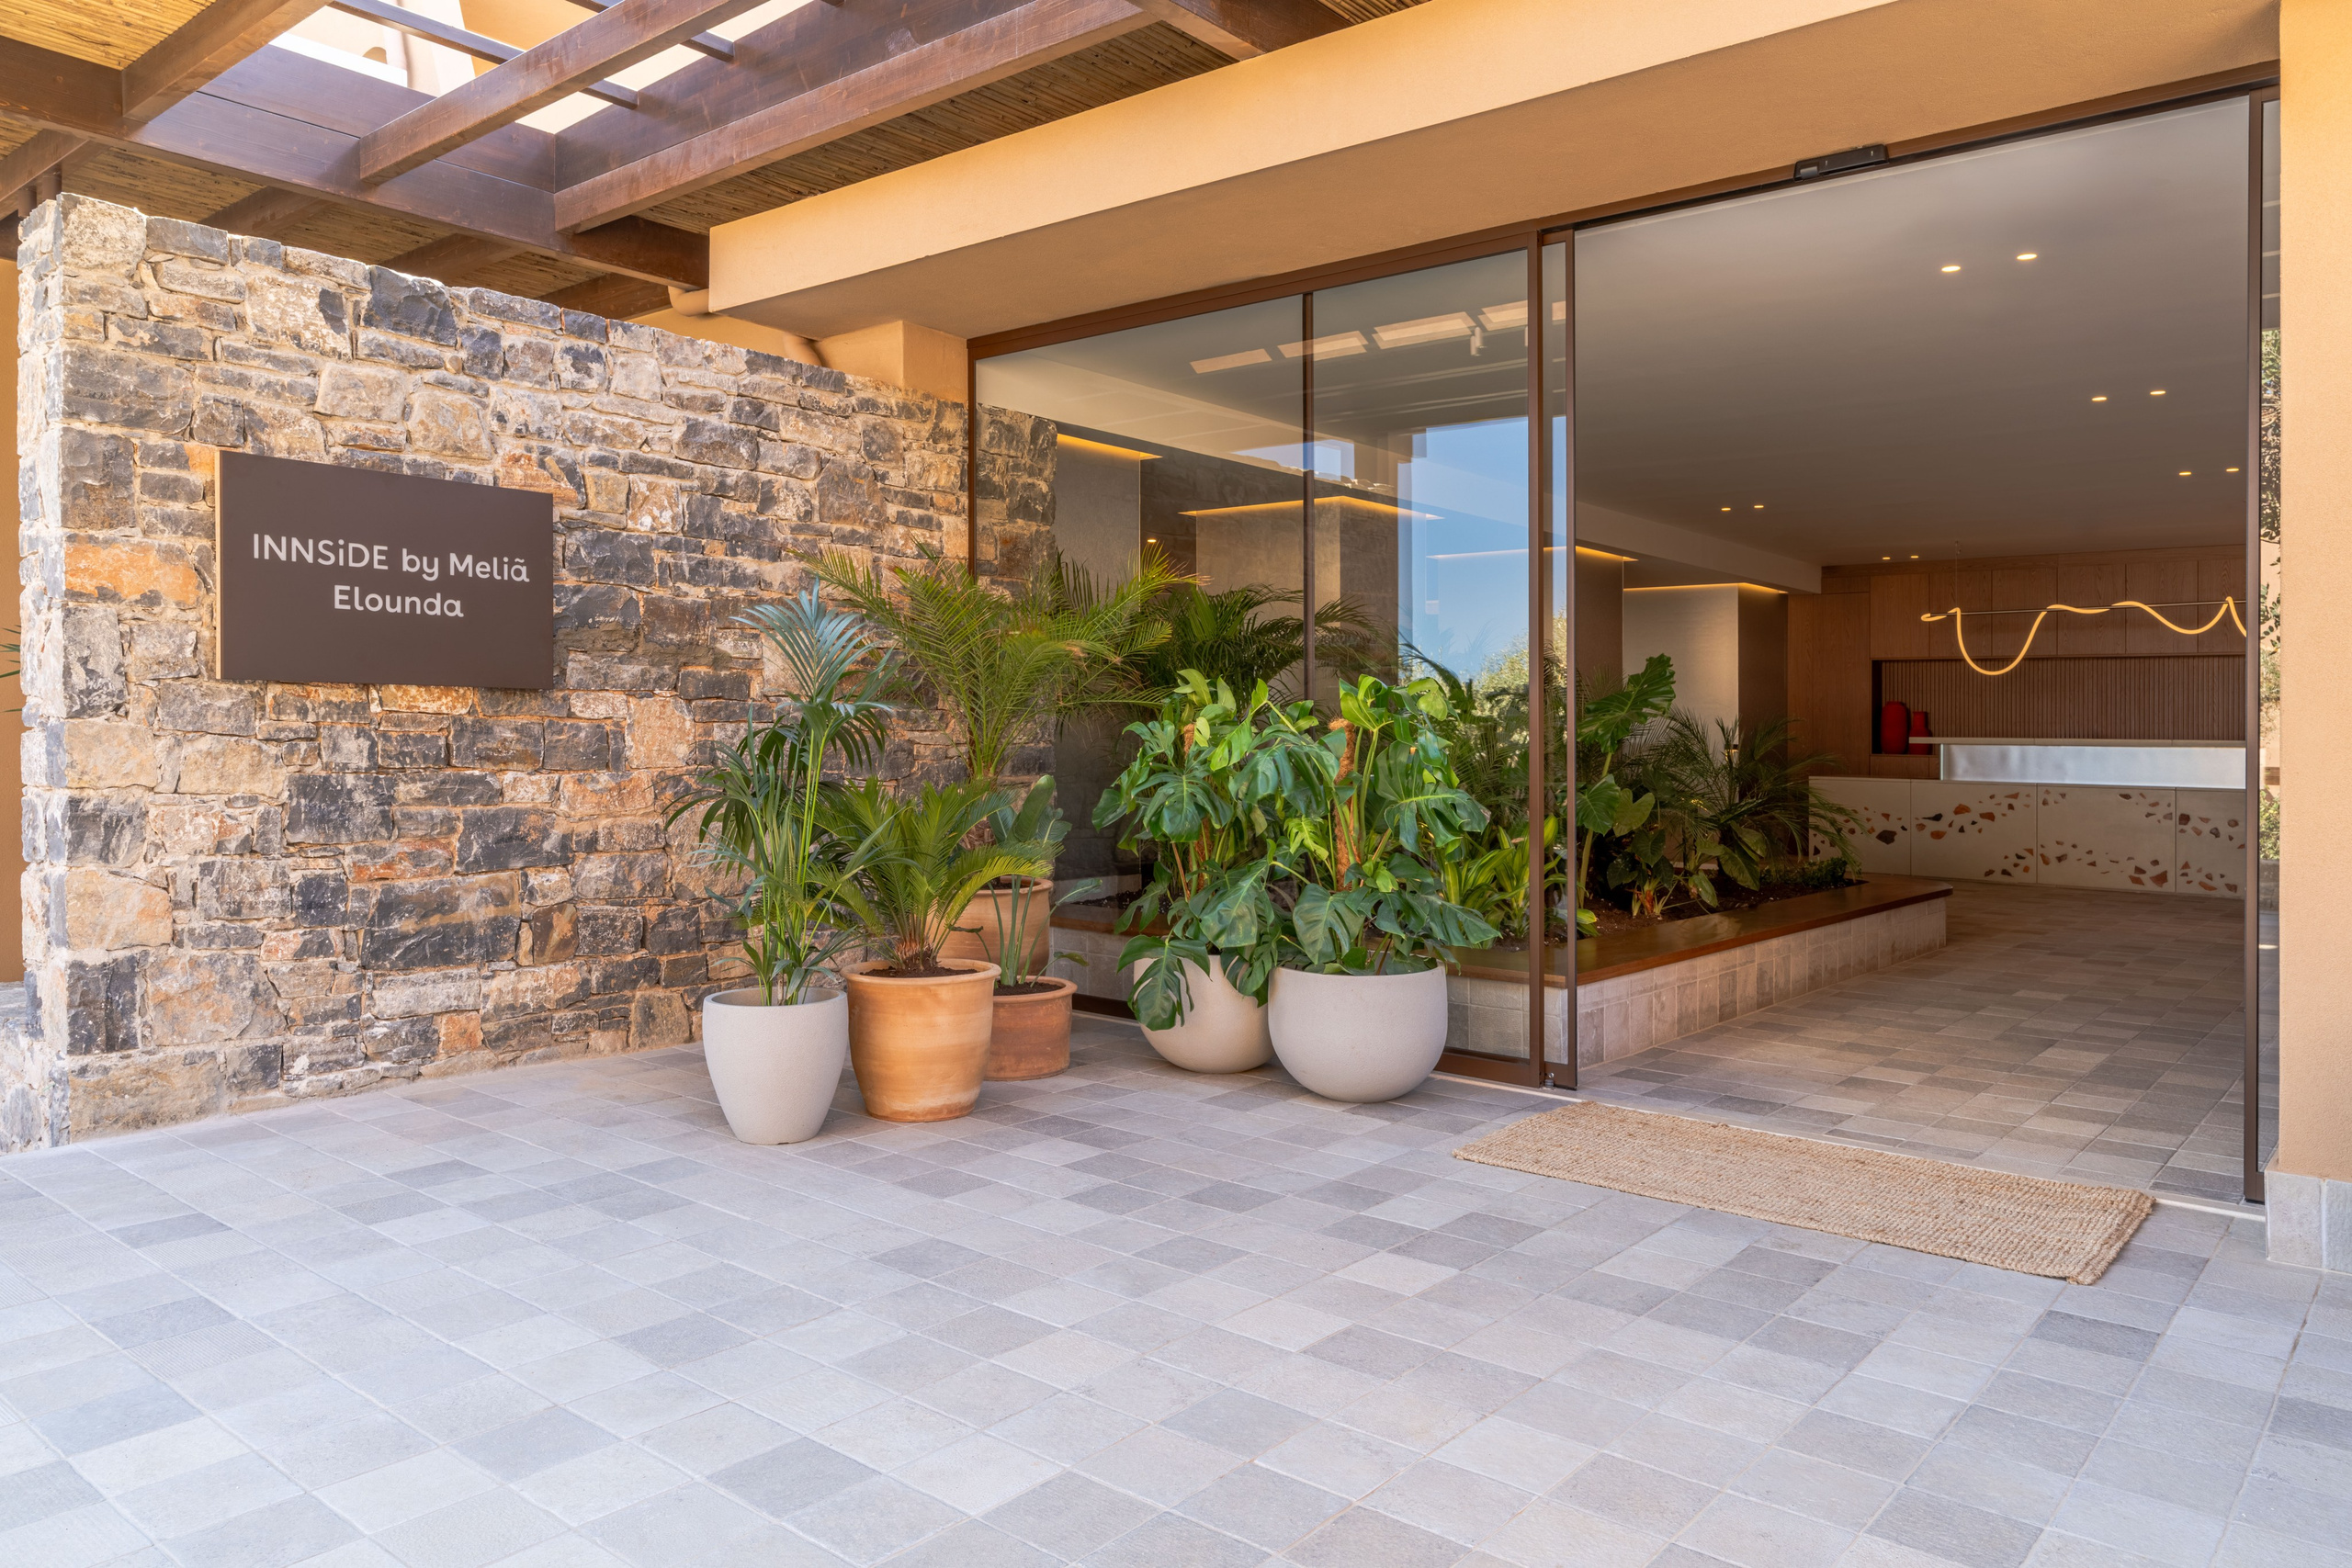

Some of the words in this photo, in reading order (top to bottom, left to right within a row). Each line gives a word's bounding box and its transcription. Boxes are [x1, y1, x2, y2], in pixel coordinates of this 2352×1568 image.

[253, 533, 389, 570] INNSiDE
[401, 547, 439, 581] by
[334, 584, 464, 617] Elounda
